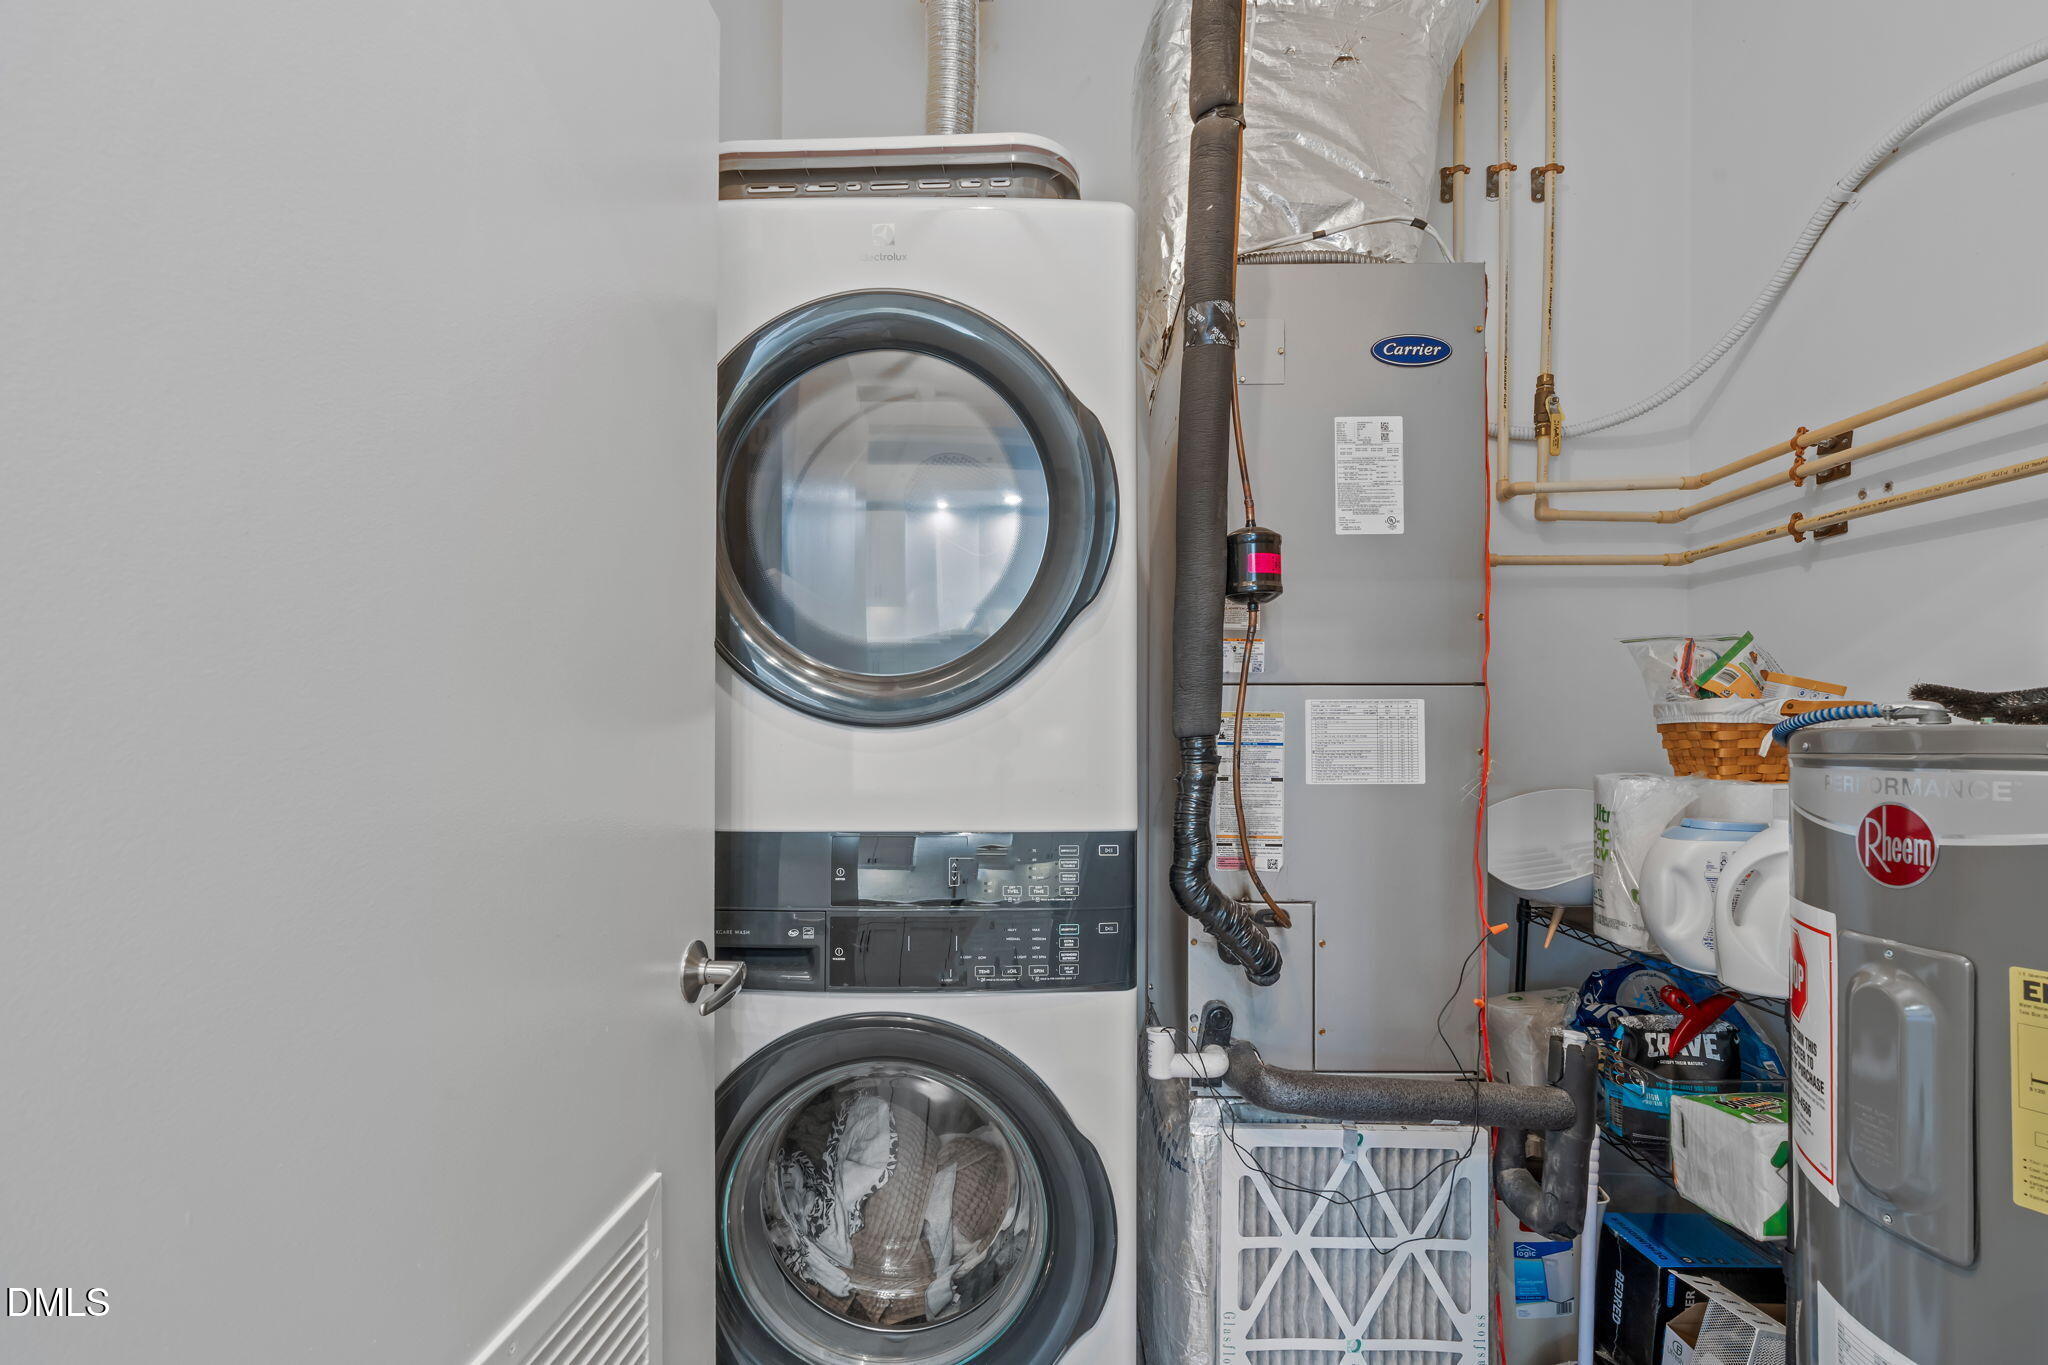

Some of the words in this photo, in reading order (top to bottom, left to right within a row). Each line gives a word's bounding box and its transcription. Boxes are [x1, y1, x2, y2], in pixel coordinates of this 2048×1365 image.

[858, 252, 908, 262] lectrolux
[1383, 342, 1442, 356] Carrier
[1865, 805, 1931, 873] Rheem
[1804, 1035, 1818, 1057] THIS
[1807, 1053, 1815, 1070] TO
[1798, 1061, 1825, 1095] PURCHASE
[1612, 1269, 1625, 1325] BEDRED
